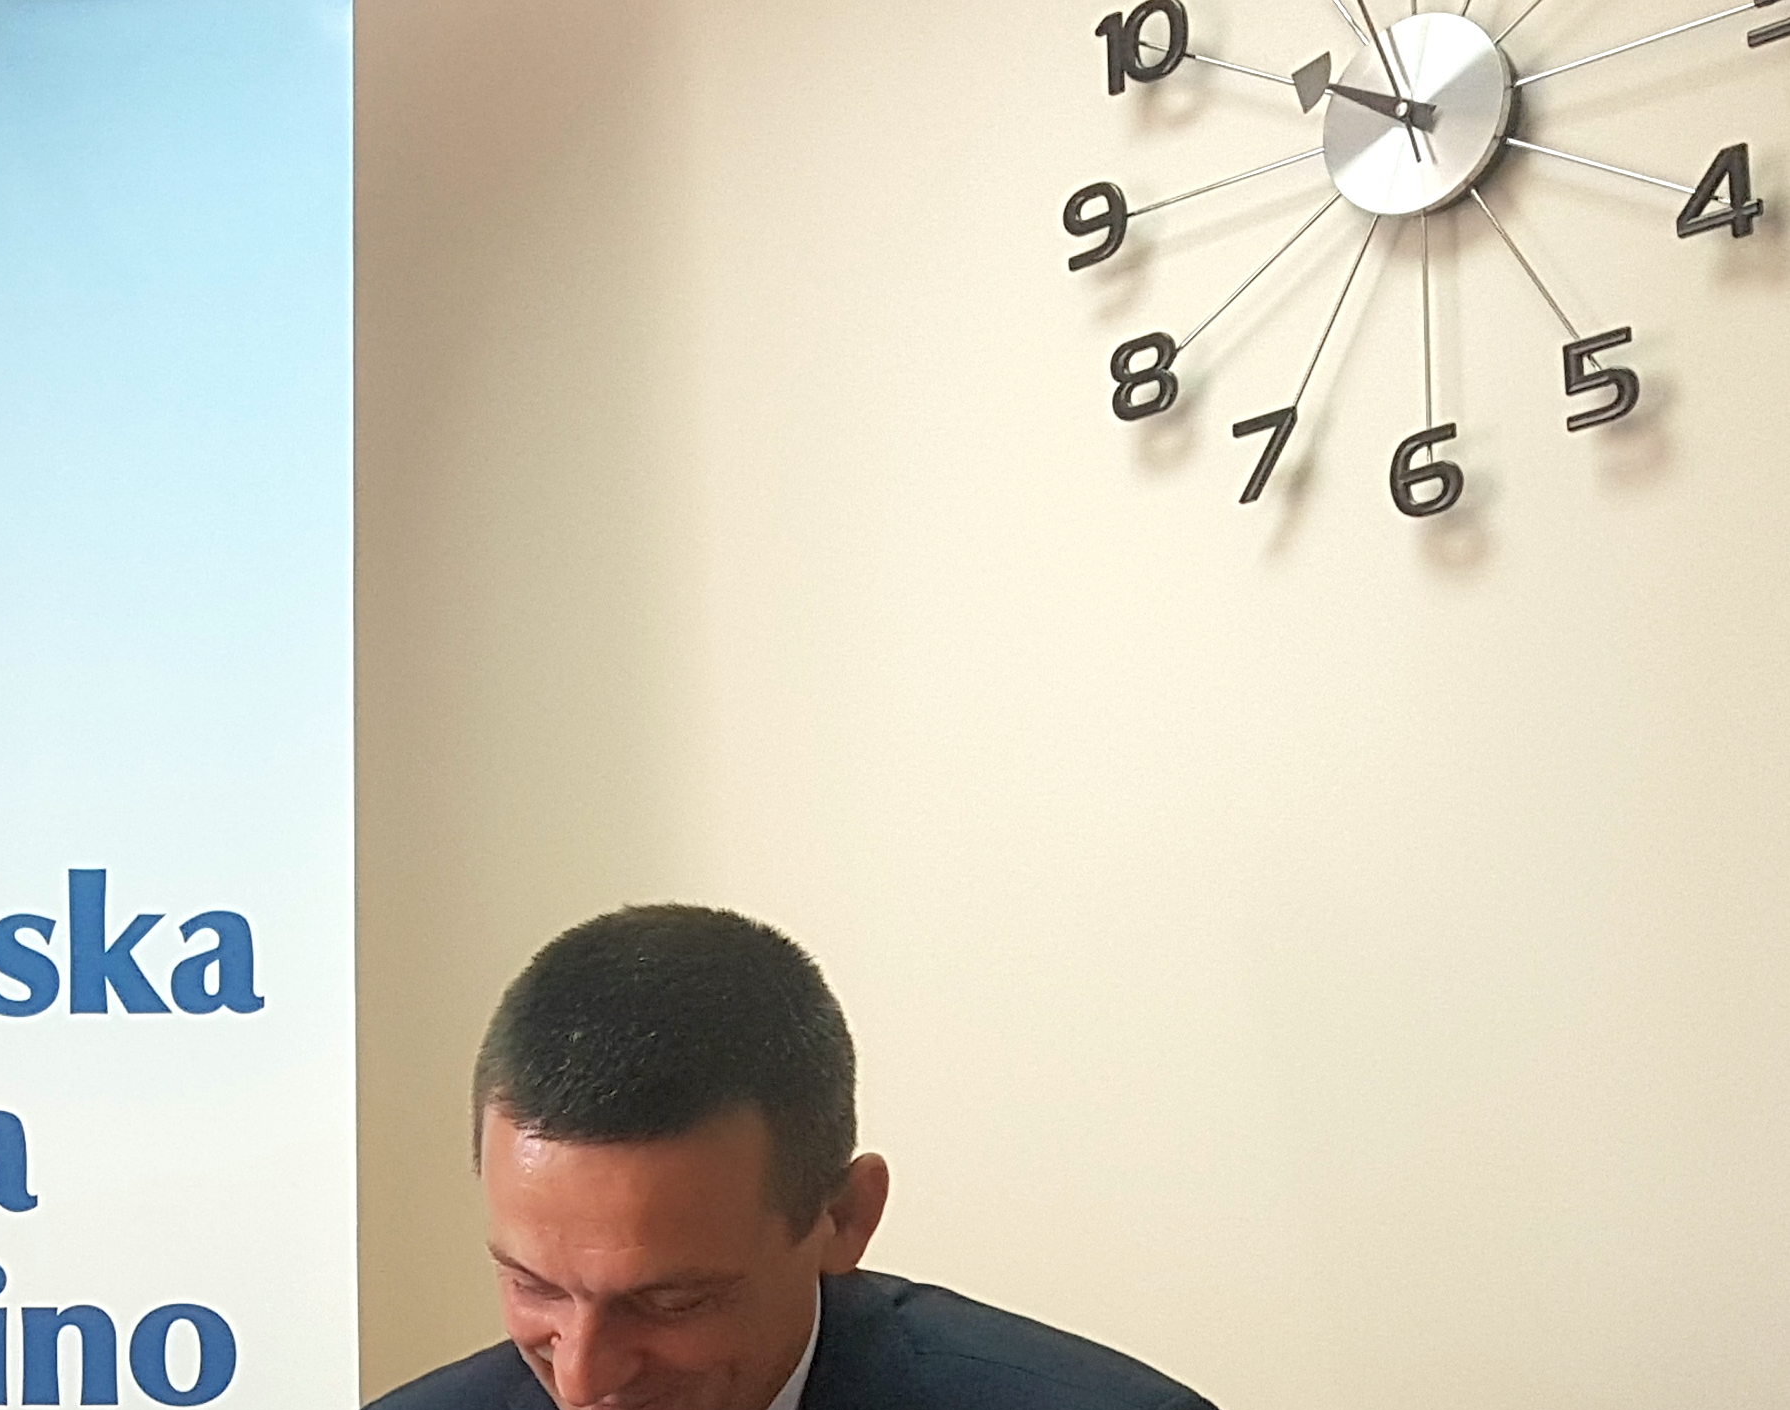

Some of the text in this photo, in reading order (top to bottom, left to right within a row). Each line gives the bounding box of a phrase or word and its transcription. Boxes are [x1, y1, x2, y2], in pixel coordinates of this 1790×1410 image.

[1095, 0, 1189, 96] 10
[1063, 181, 1127, 271] 9
[1676, 142, 1764, 239] 4
[1110, 332, 1179, 421] 8
[1562, 326, 1640, 432] 5
[1232, 405, 1298, 504] 7
[1389, 422, 1464, 518] 6
